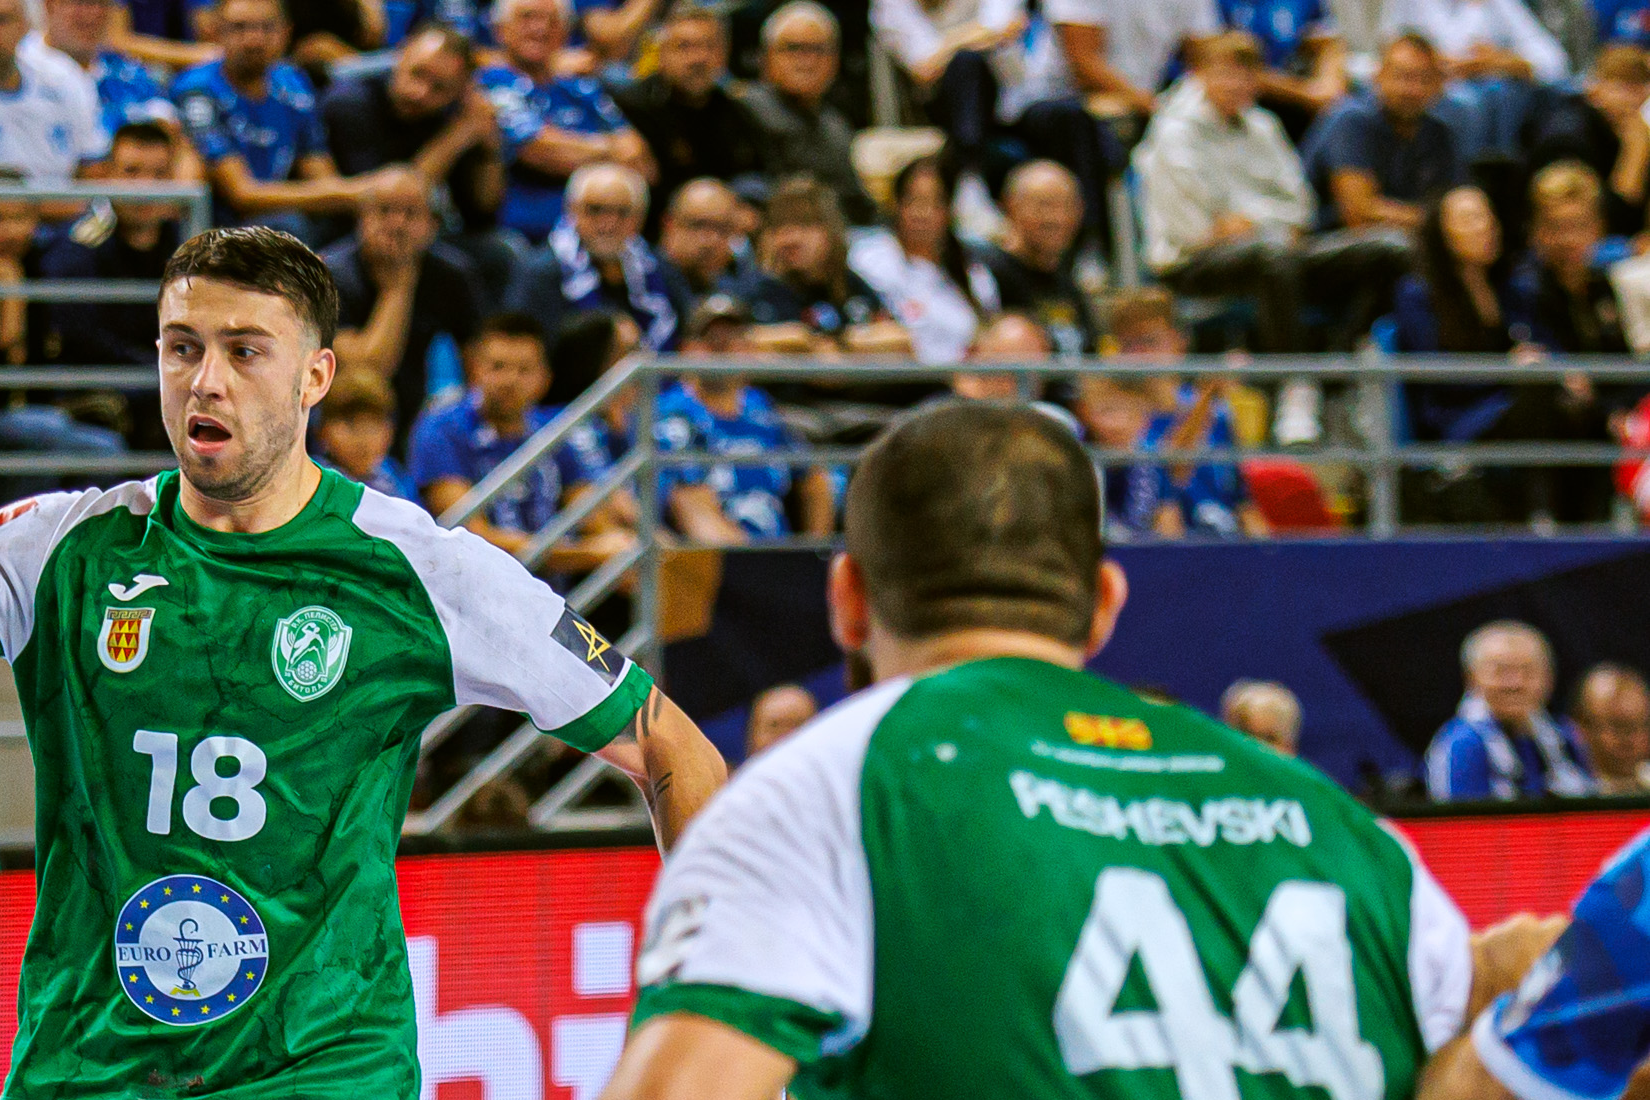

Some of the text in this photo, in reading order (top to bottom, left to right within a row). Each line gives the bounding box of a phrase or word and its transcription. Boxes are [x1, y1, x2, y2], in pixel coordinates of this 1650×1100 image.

[133, 729, 267, 842] 18
[1009, 769, 1312, 847] PESHEVSKI
[118, 938, 267, 962] EURO FARM
